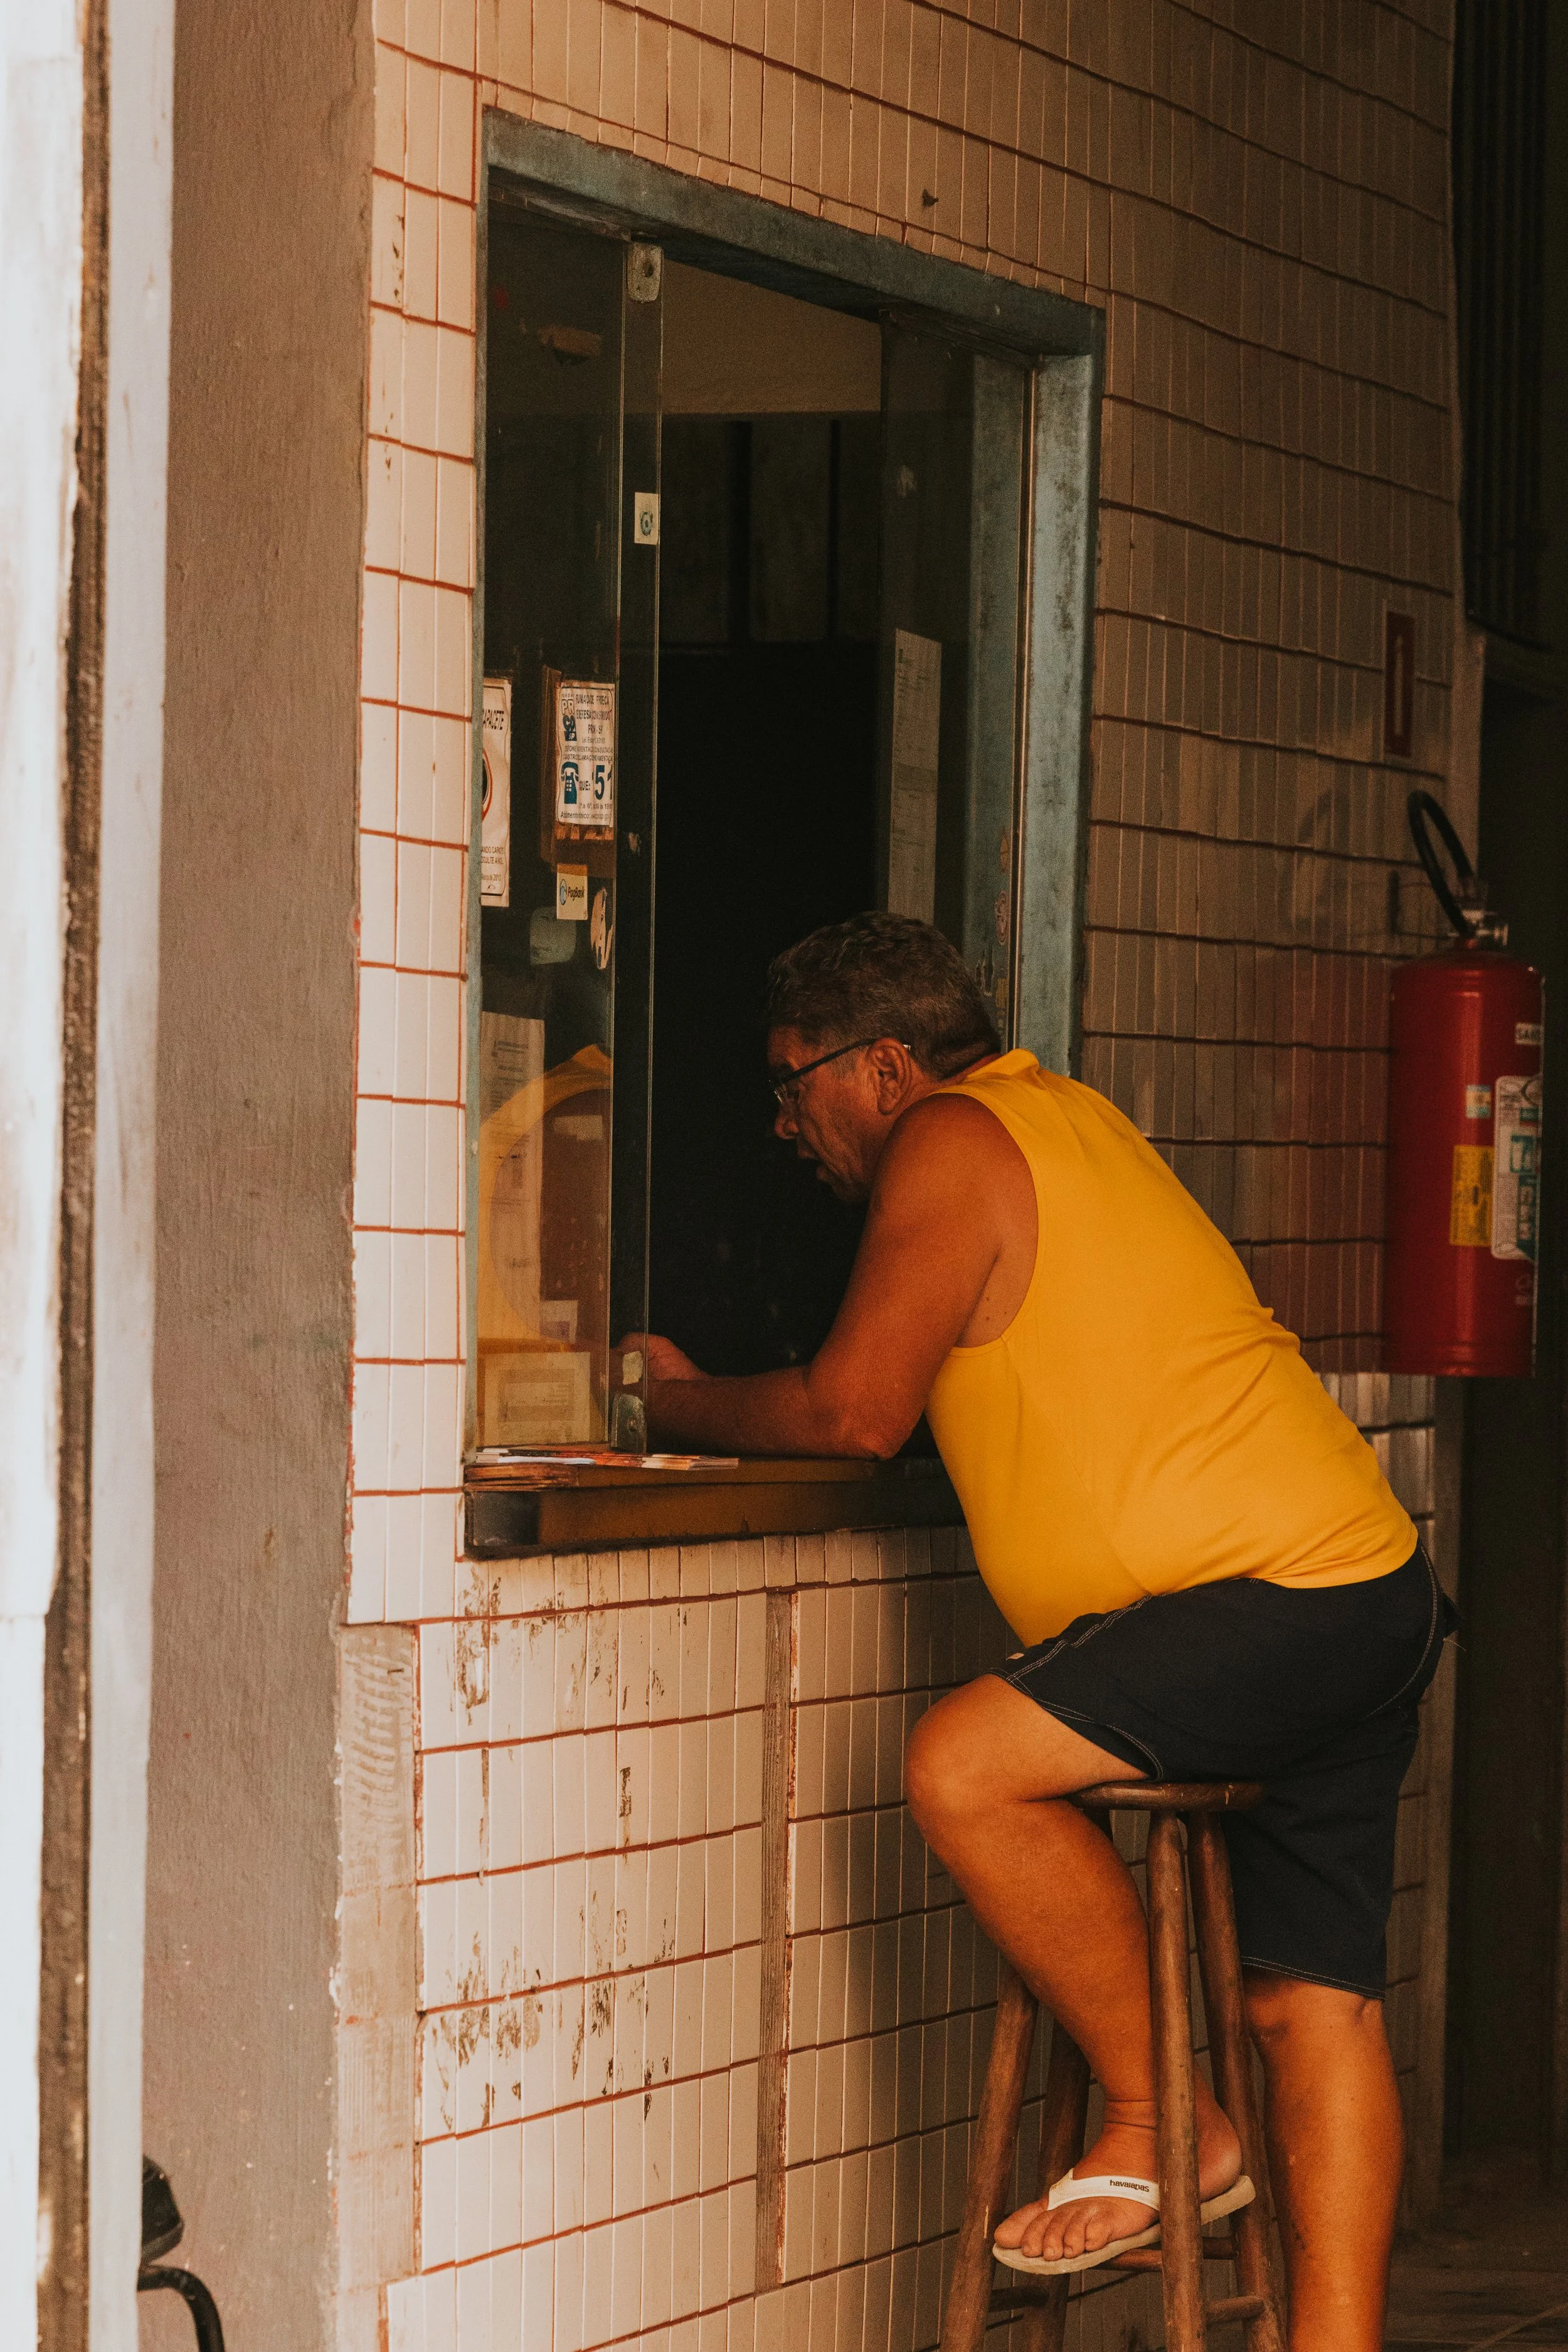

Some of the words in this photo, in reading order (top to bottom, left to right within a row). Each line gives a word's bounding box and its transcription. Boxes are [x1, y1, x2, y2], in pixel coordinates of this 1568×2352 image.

[482, 709, 504, 730] APACETE
[592, 765, 613, 800] 51
[568, 887, 585, 901] PagBank
[1110, 2180, 1150, 2193] havaianas
